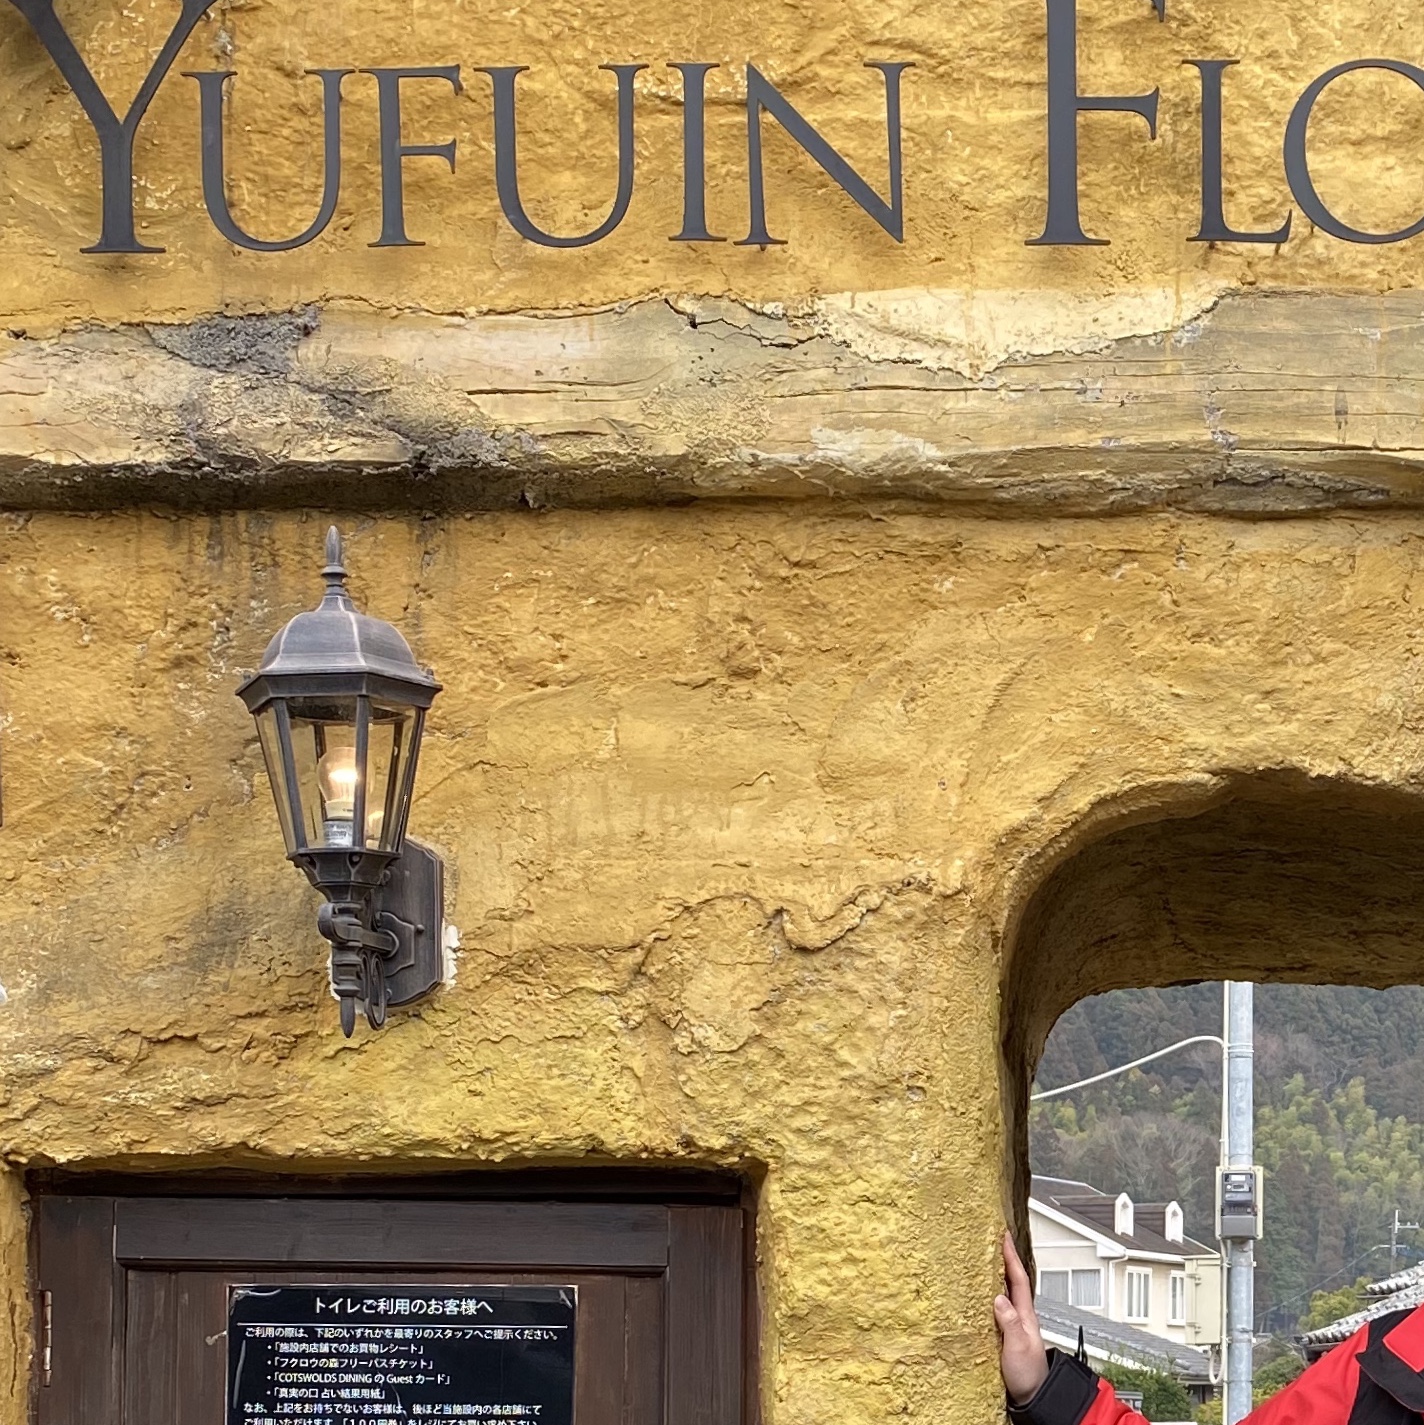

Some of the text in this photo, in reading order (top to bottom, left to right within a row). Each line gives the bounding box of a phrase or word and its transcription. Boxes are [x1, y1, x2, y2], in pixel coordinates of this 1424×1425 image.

[6, 0, 916, 254] YUFUIN
[338, 1373, 372, 1383] DINING
[374, 1373, 384, 1384] の
[386, 1373, 413, 1383] Guest
